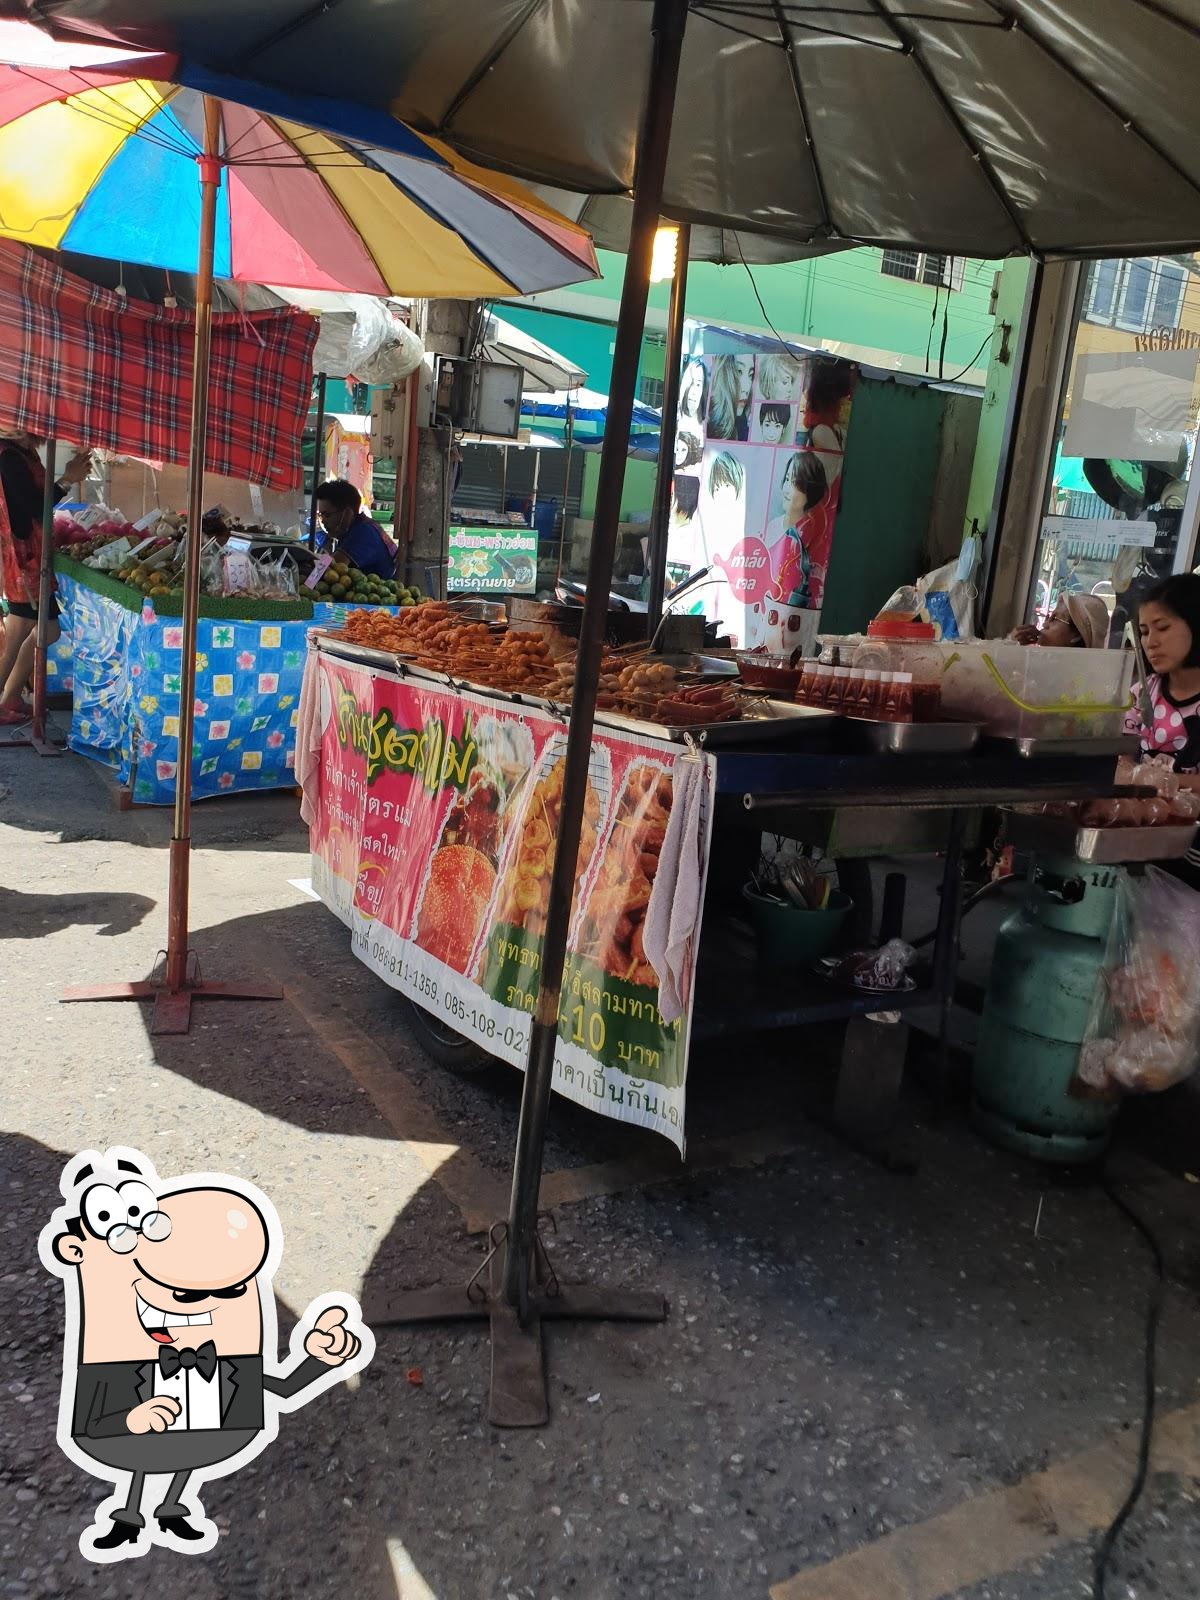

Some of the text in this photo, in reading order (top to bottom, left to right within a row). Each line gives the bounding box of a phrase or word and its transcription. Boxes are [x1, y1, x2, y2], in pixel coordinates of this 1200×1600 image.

[447, 577, 516, 592] สูตรคุณยาย
[736, 577, 757, 591] เจล
[444, 991, 530, 1057] 085-108-02
[617, 1040, 660, 1069] บาท
[554, 1058, 682, 1128] าคาเป็นกันเอ
